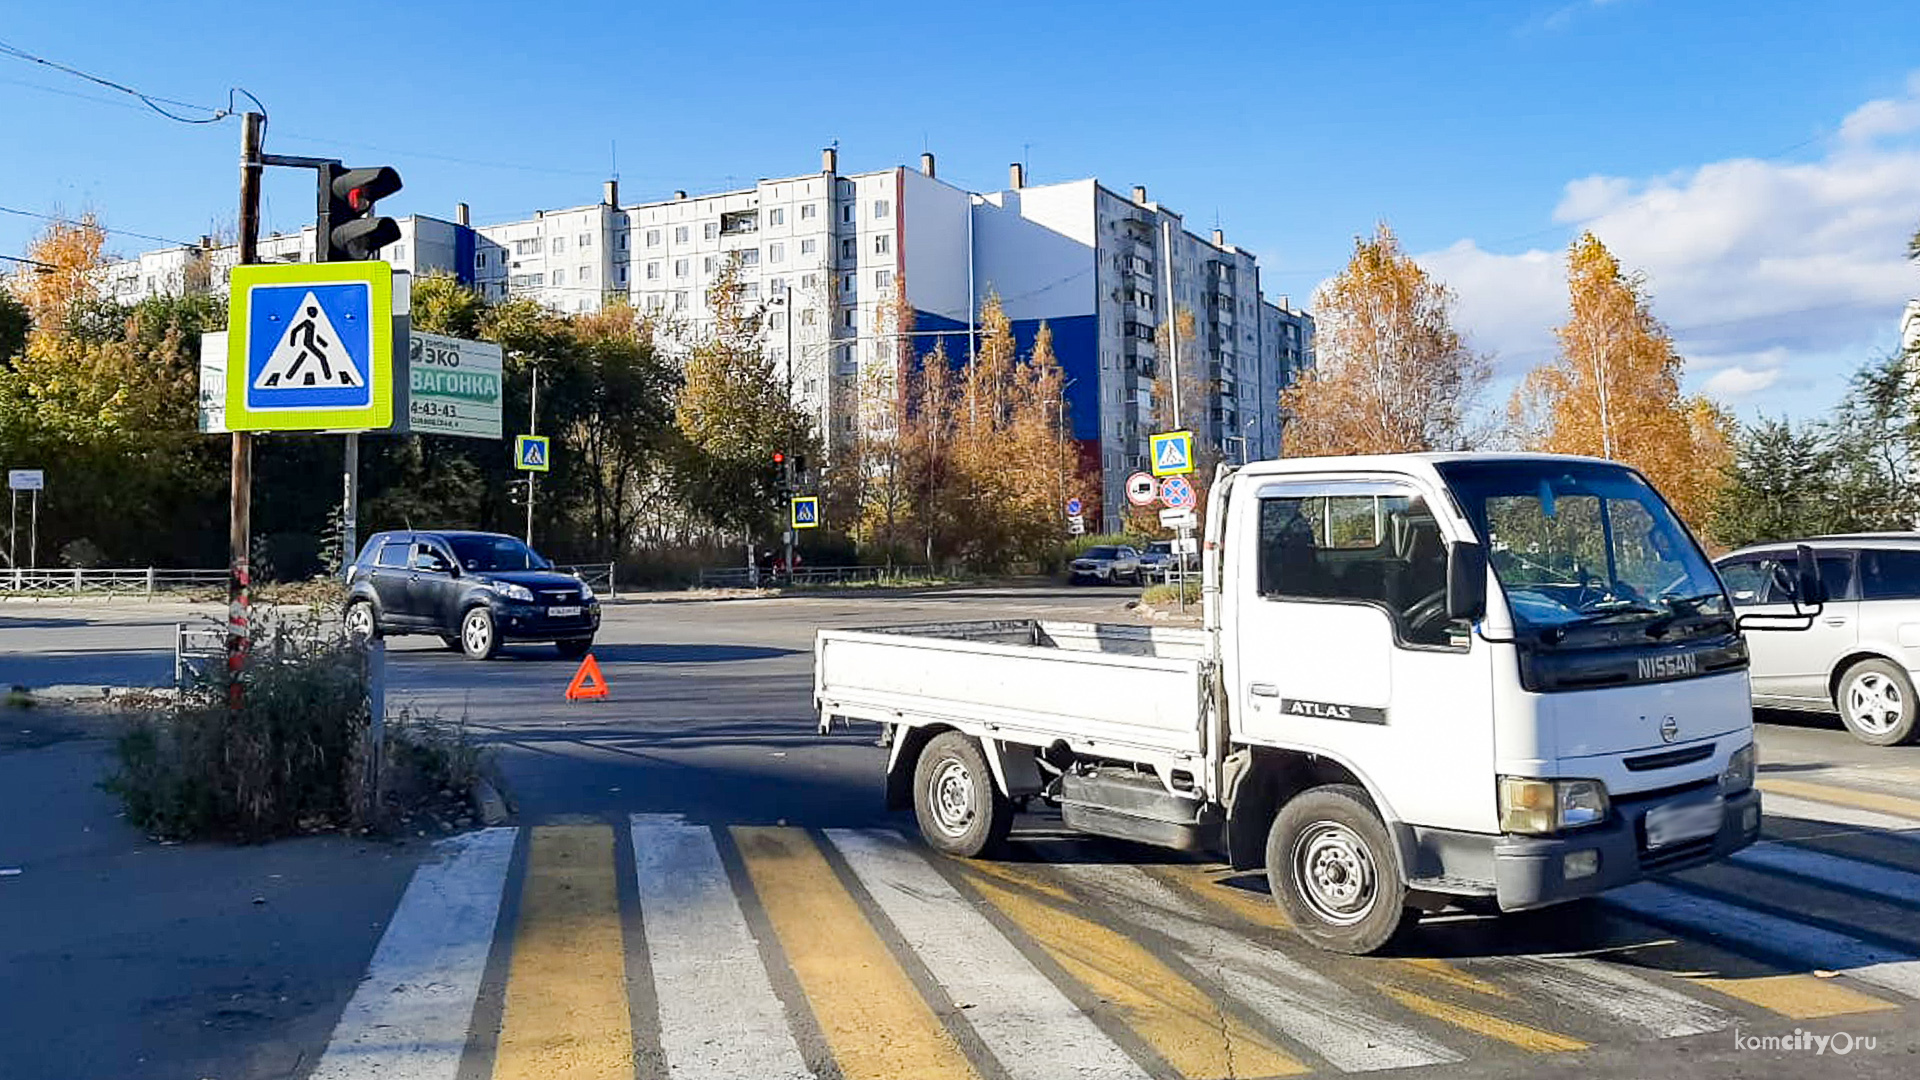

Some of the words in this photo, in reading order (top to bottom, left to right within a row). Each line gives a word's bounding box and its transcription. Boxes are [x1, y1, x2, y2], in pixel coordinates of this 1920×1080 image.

[425, 348, 460, 368] ЭКО
[411, 370, 497, 396] ВАГОНКА
[1638, 652, 1697, 679] NISSAN
[1290, 701, 1352, 718] ATLAS
